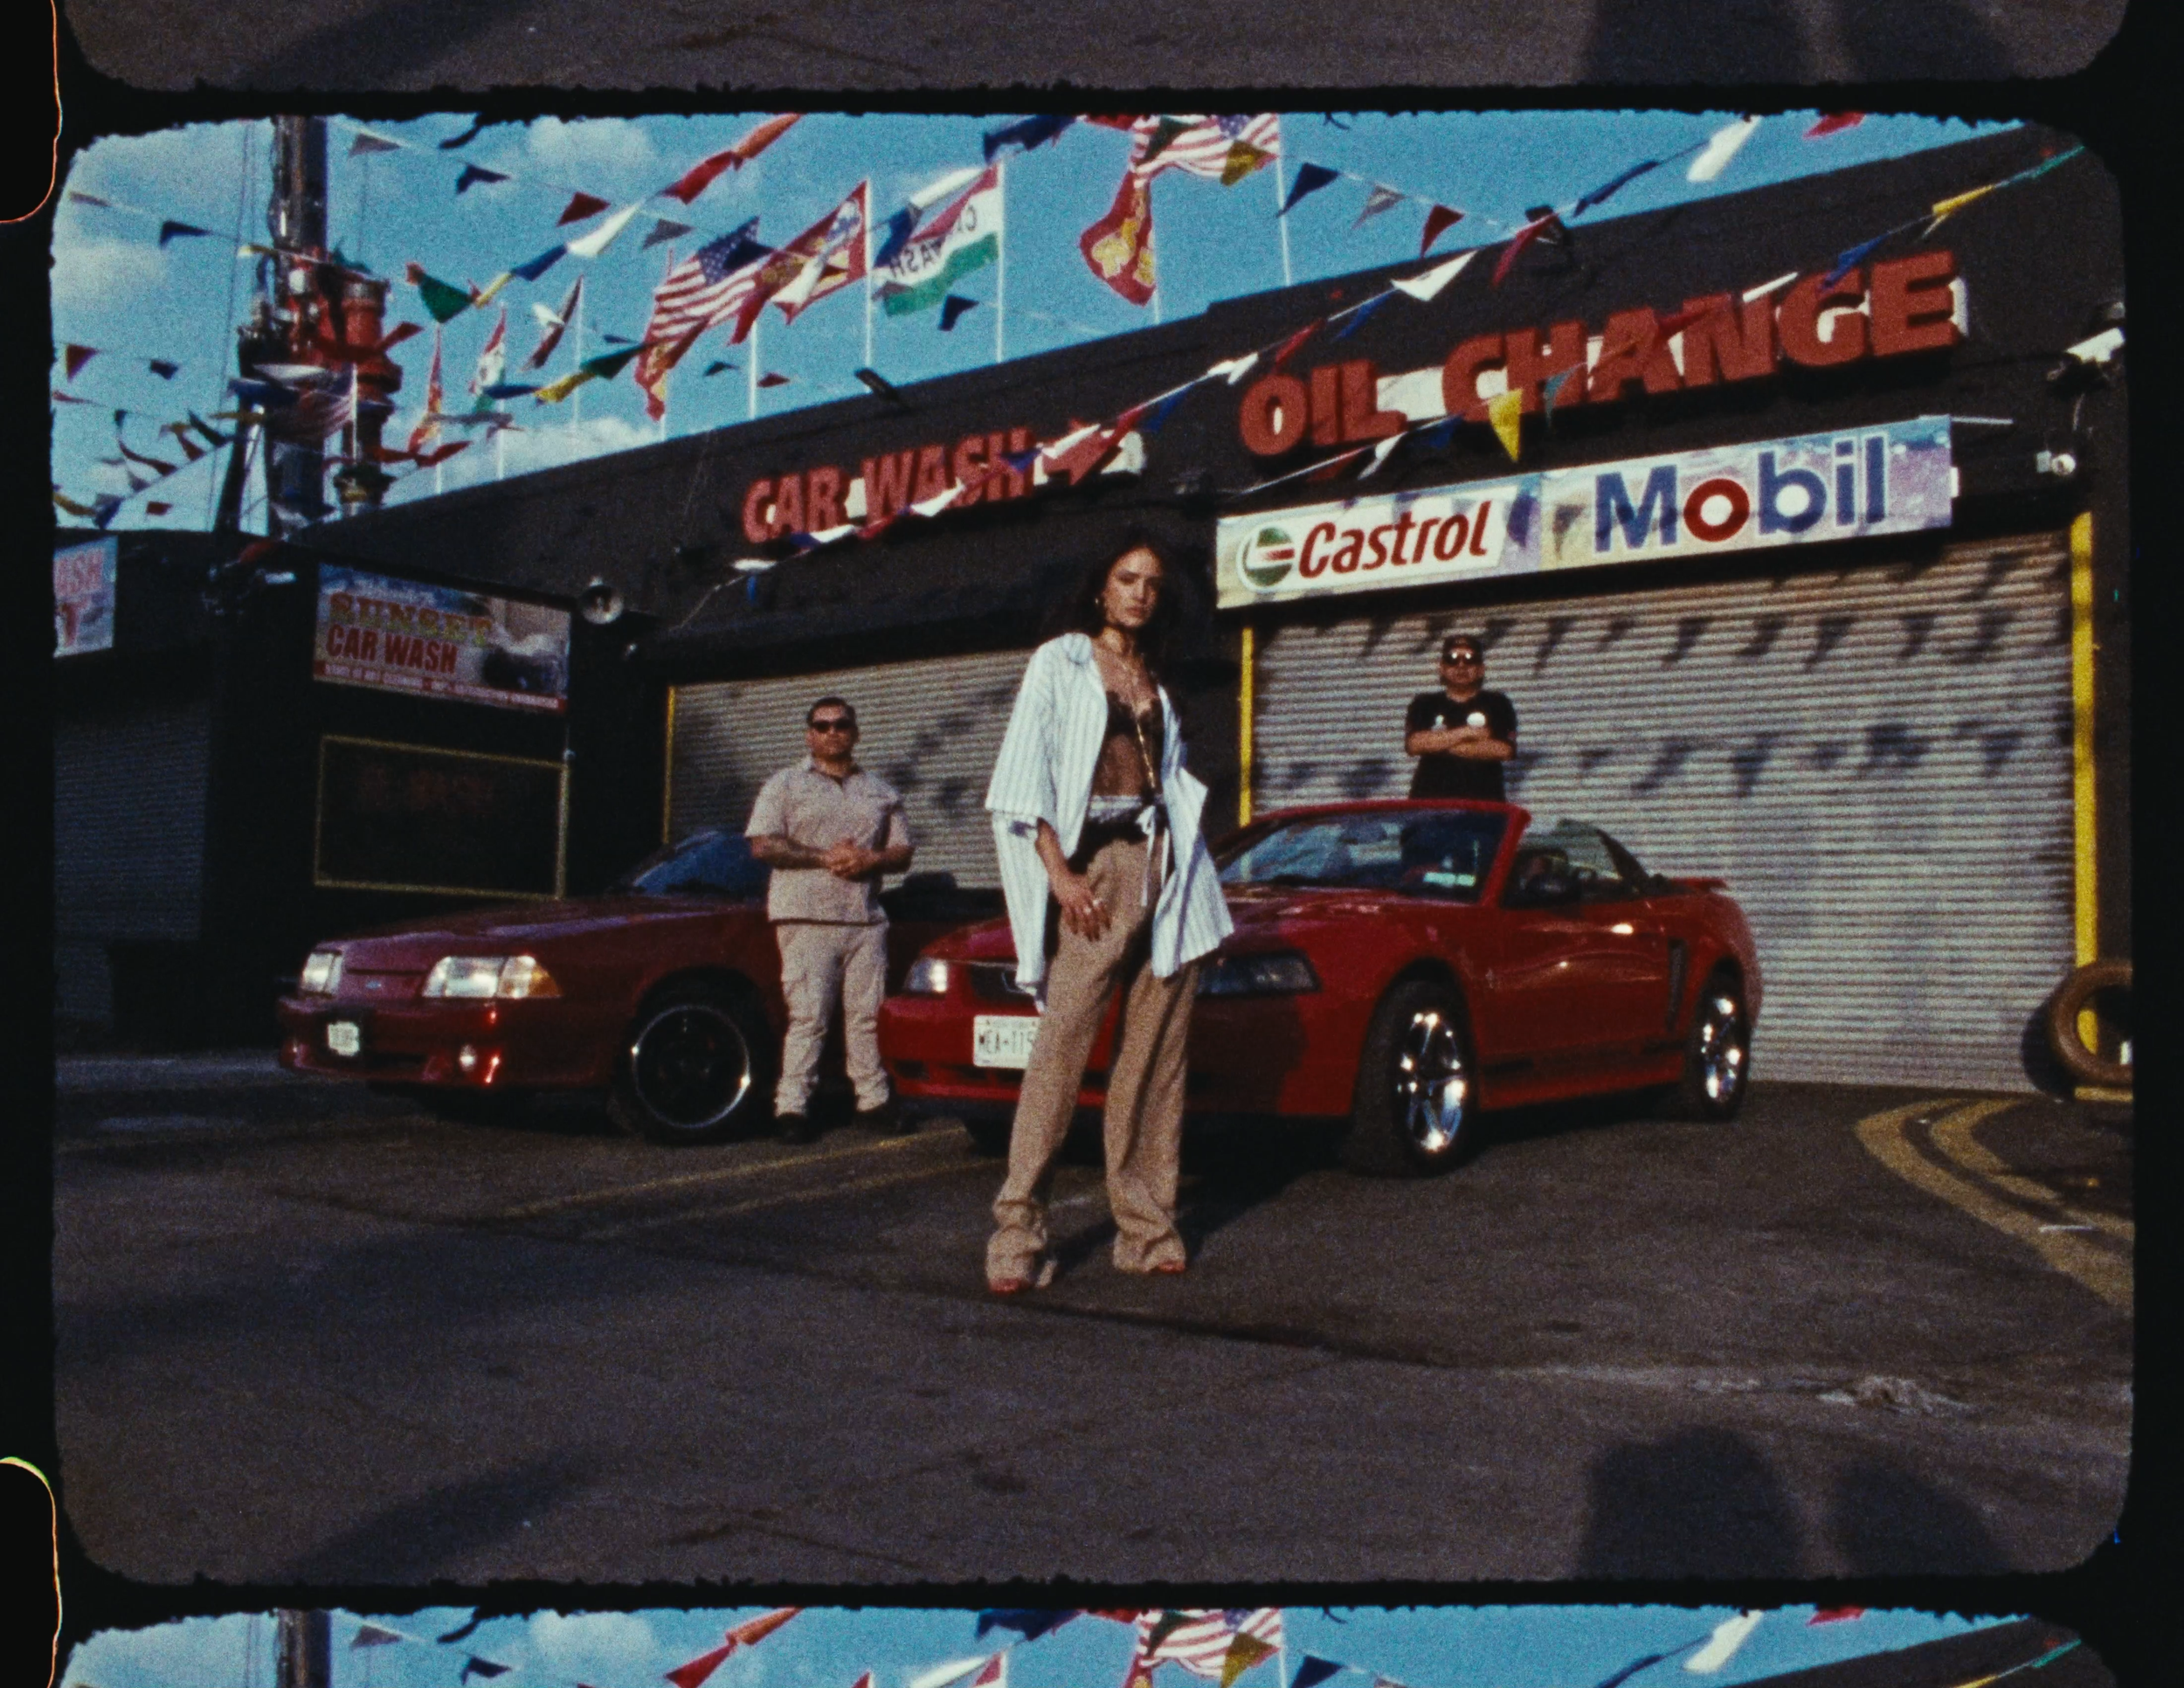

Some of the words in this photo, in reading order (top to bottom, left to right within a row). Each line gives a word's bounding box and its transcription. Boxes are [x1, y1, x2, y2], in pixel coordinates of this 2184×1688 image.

[1239, 359, 1407, 456] OIL
[1441, 249, 1956, 423] CHANGE
[742, 466, 845, 543] CAR
[860, 428, 1034, 522] WASH
[1594, 436, 1886, 553] Mobil
[55, 549, 103, 596] ASH
[1298, 501, 1493, 578] Castrol
[326, 624, 378, 661] CAR
[384, 632, 459, 675] WASH
[328, 591, 493, 647] SUNSET
